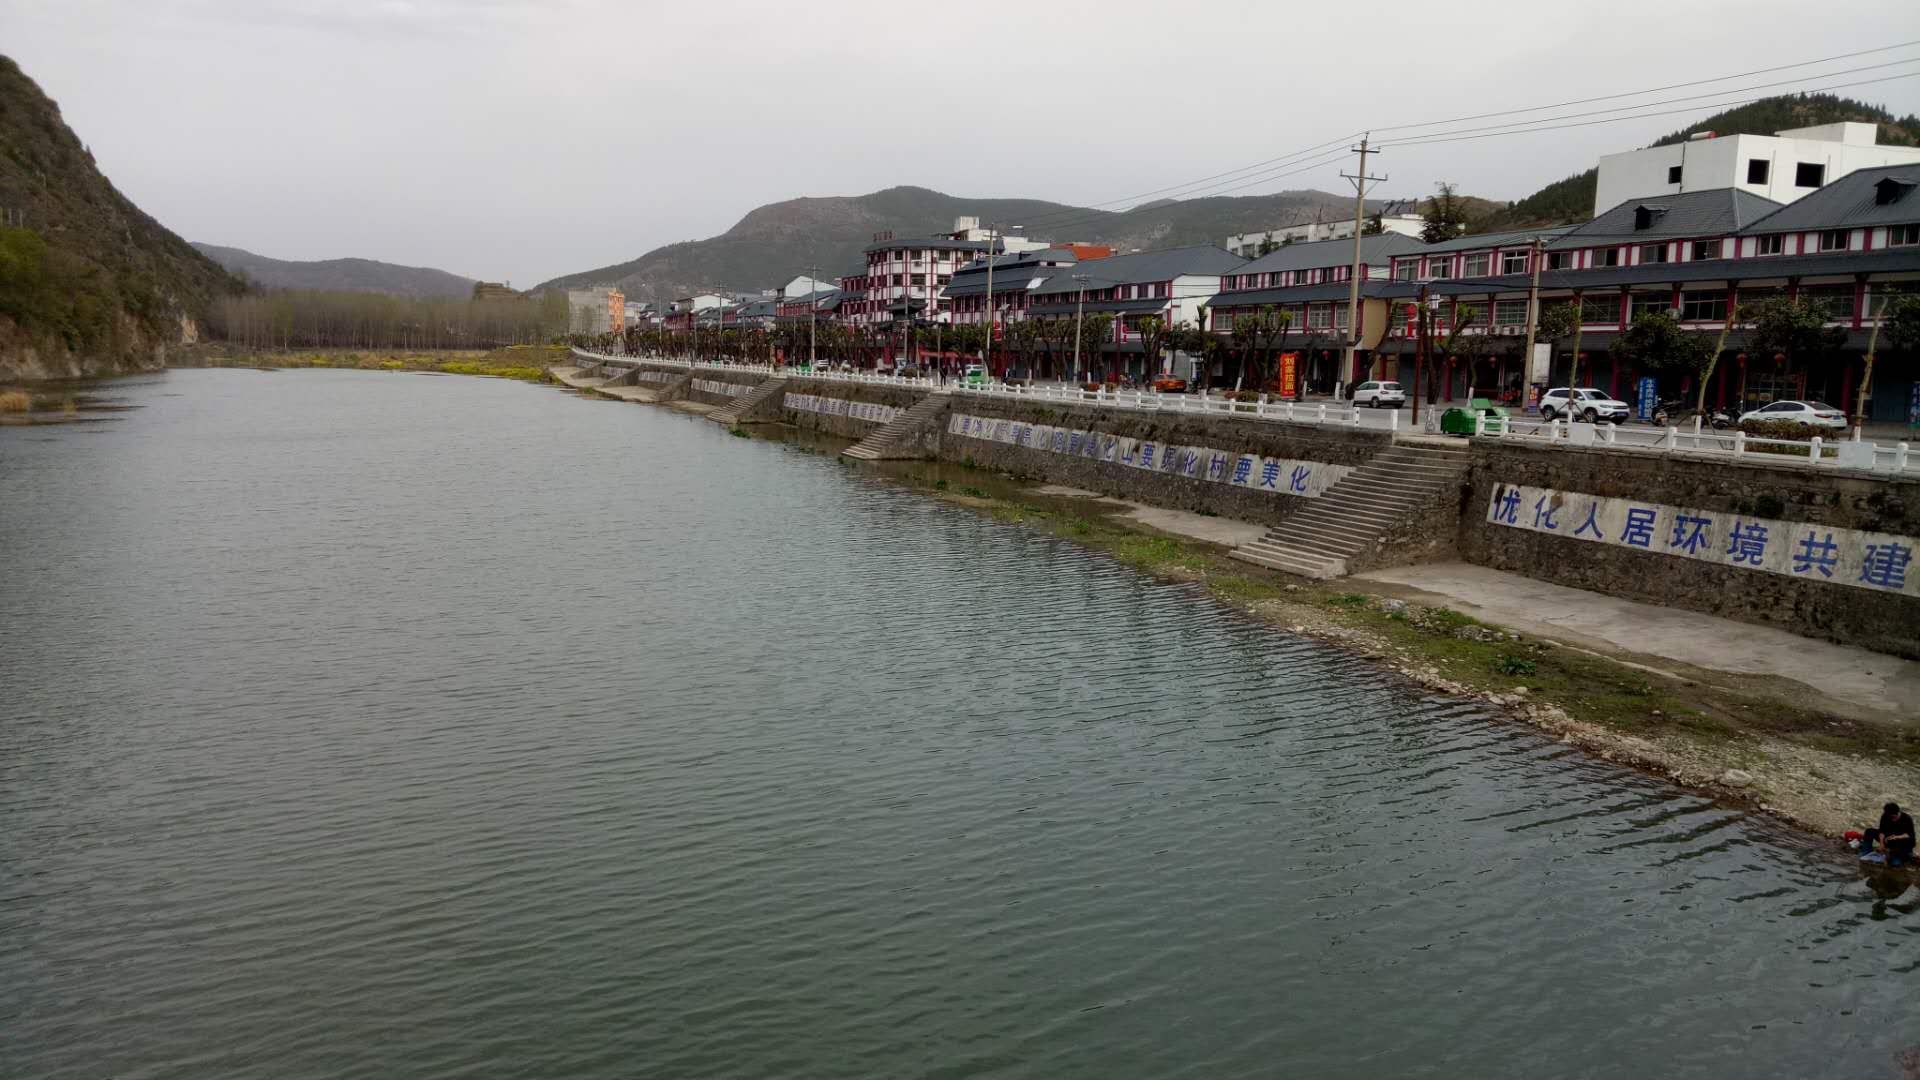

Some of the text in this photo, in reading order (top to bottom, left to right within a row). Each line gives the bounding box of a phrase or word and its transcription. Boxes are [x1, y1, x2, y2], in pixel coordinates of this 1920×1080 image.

[1493, 488, 1913, 589] 优化人居环境共建
